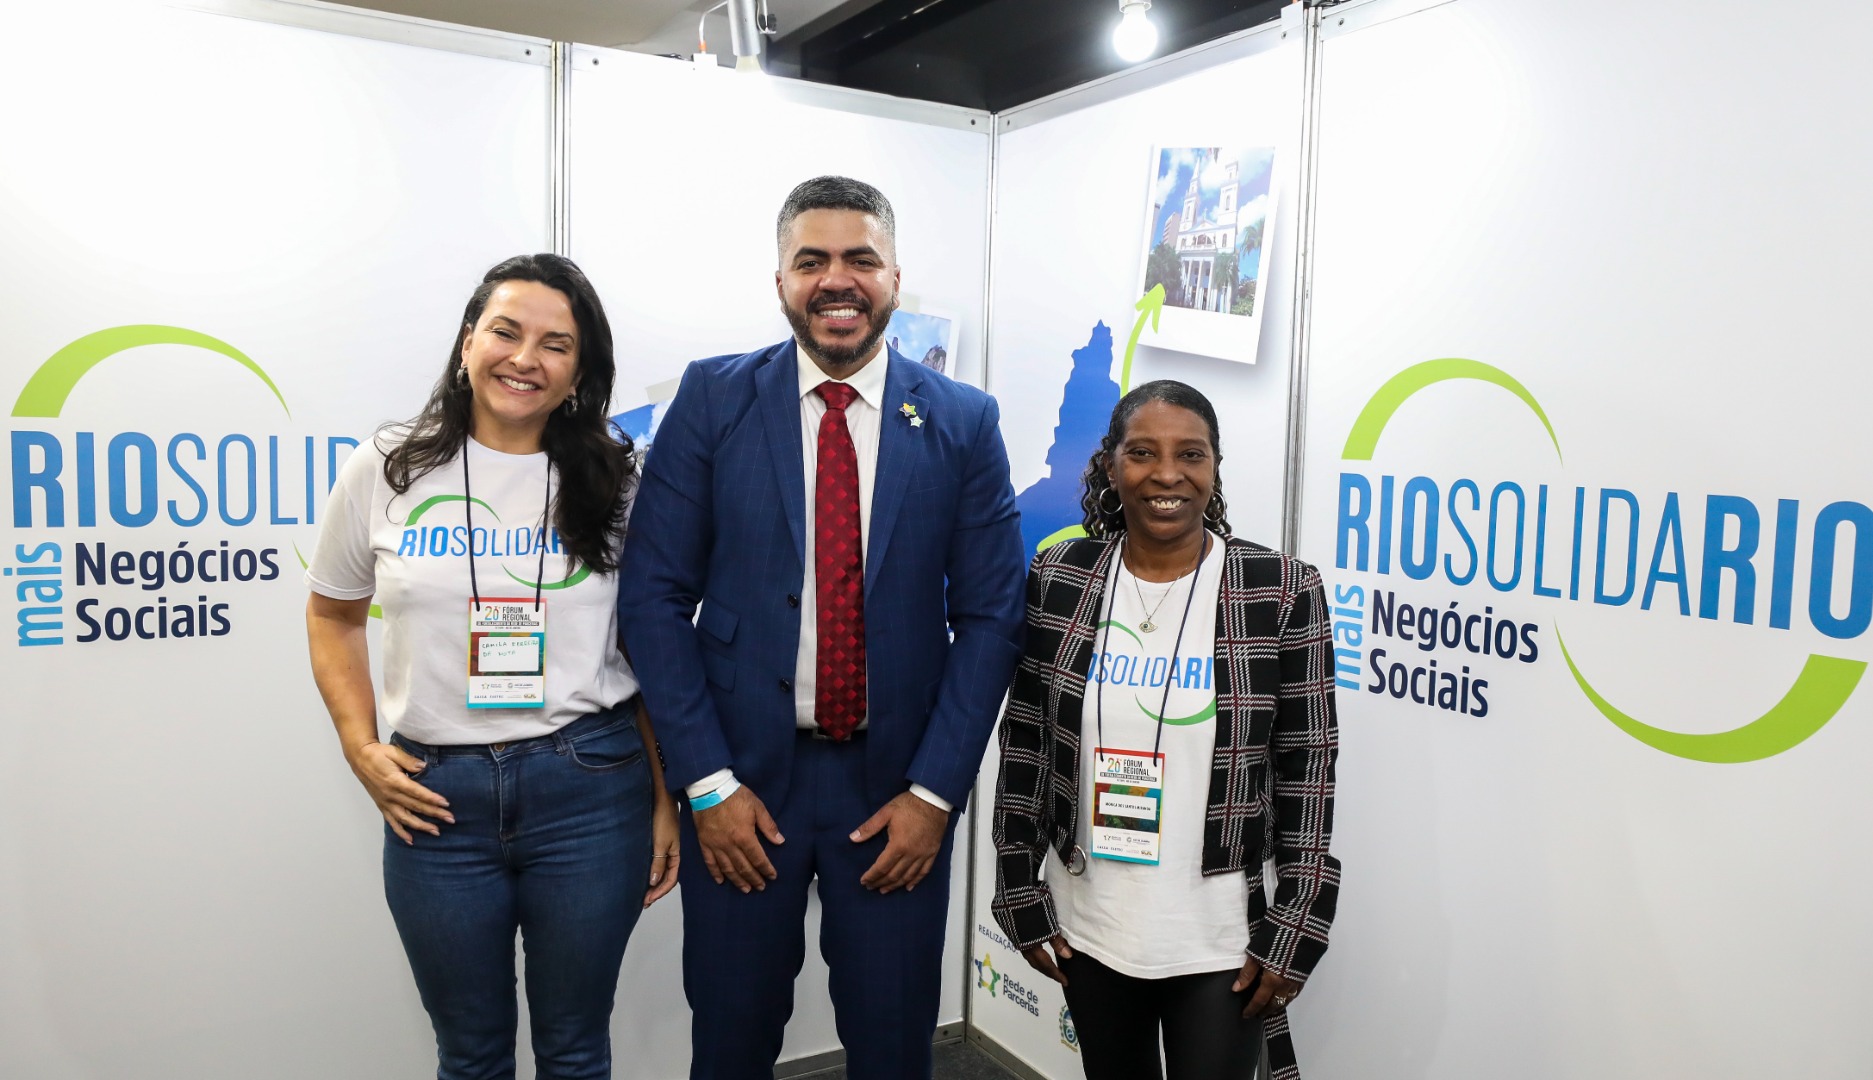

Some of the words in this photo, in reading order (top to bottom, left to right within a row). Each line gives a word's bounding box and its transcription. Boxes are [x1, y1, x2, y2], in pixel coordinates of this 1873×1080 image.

[75, 540, 280, 591] Negócios
[1335, 472, 1873, 640] RIOSOLIDARIO
[3, 541, 64, 647] mais
[75, 595, 231, 643] Sociais
[502, 613, 531, 621] REGIONAL
[1328, 583, 1365, 691] mais
[1371, 589, 1539, 664] Negócios
[1368, 647, 1489, 718] Sociais
[1123, 766, 1150, 777] REGIONAL
[1002, 985, 1039, 1017] Parcerias
[1003, 973, 1025, 996] Rede
[1026, 989, 1039, 1004] de
